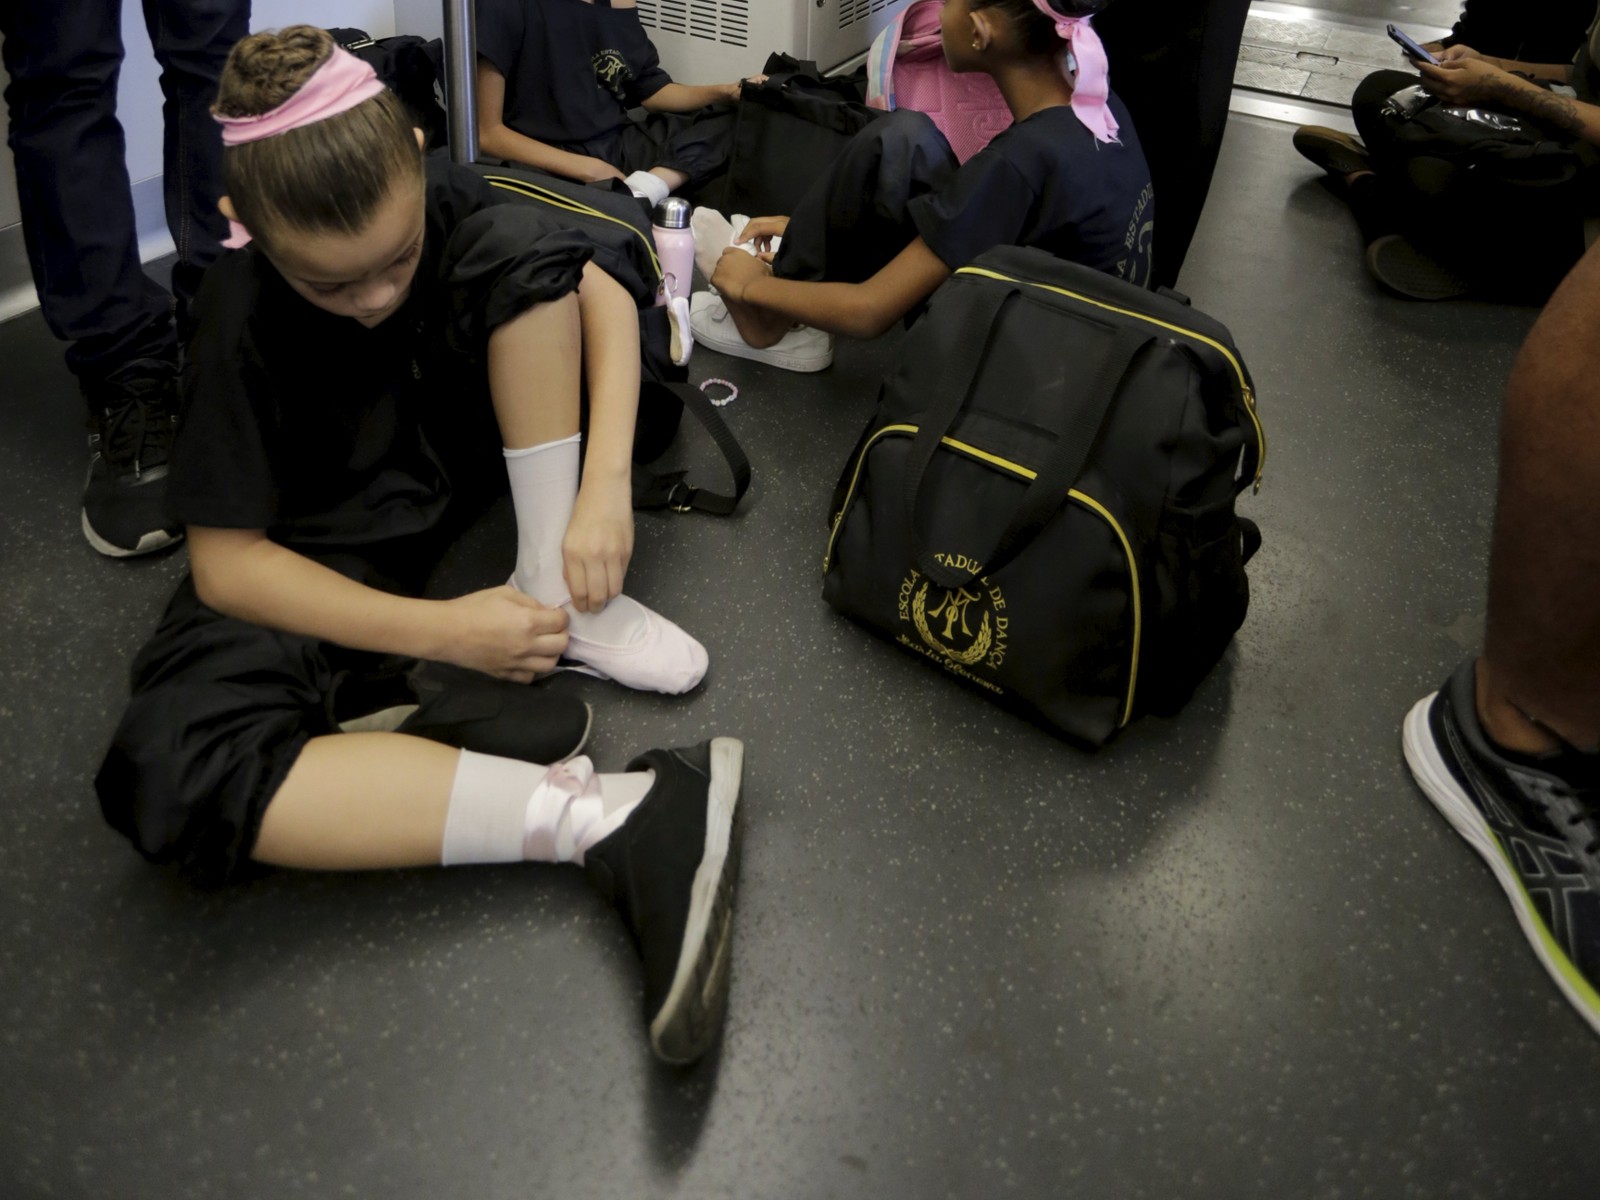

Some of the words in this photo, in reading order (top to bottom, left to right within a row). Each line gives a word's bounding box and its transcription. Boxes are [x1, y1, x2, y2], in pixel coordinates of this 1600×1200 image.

[899, 568, 921, 622] ESCOLA
[988, 584, 1007, 612] DE
[985, 615, 1009, 670] DANÇA
